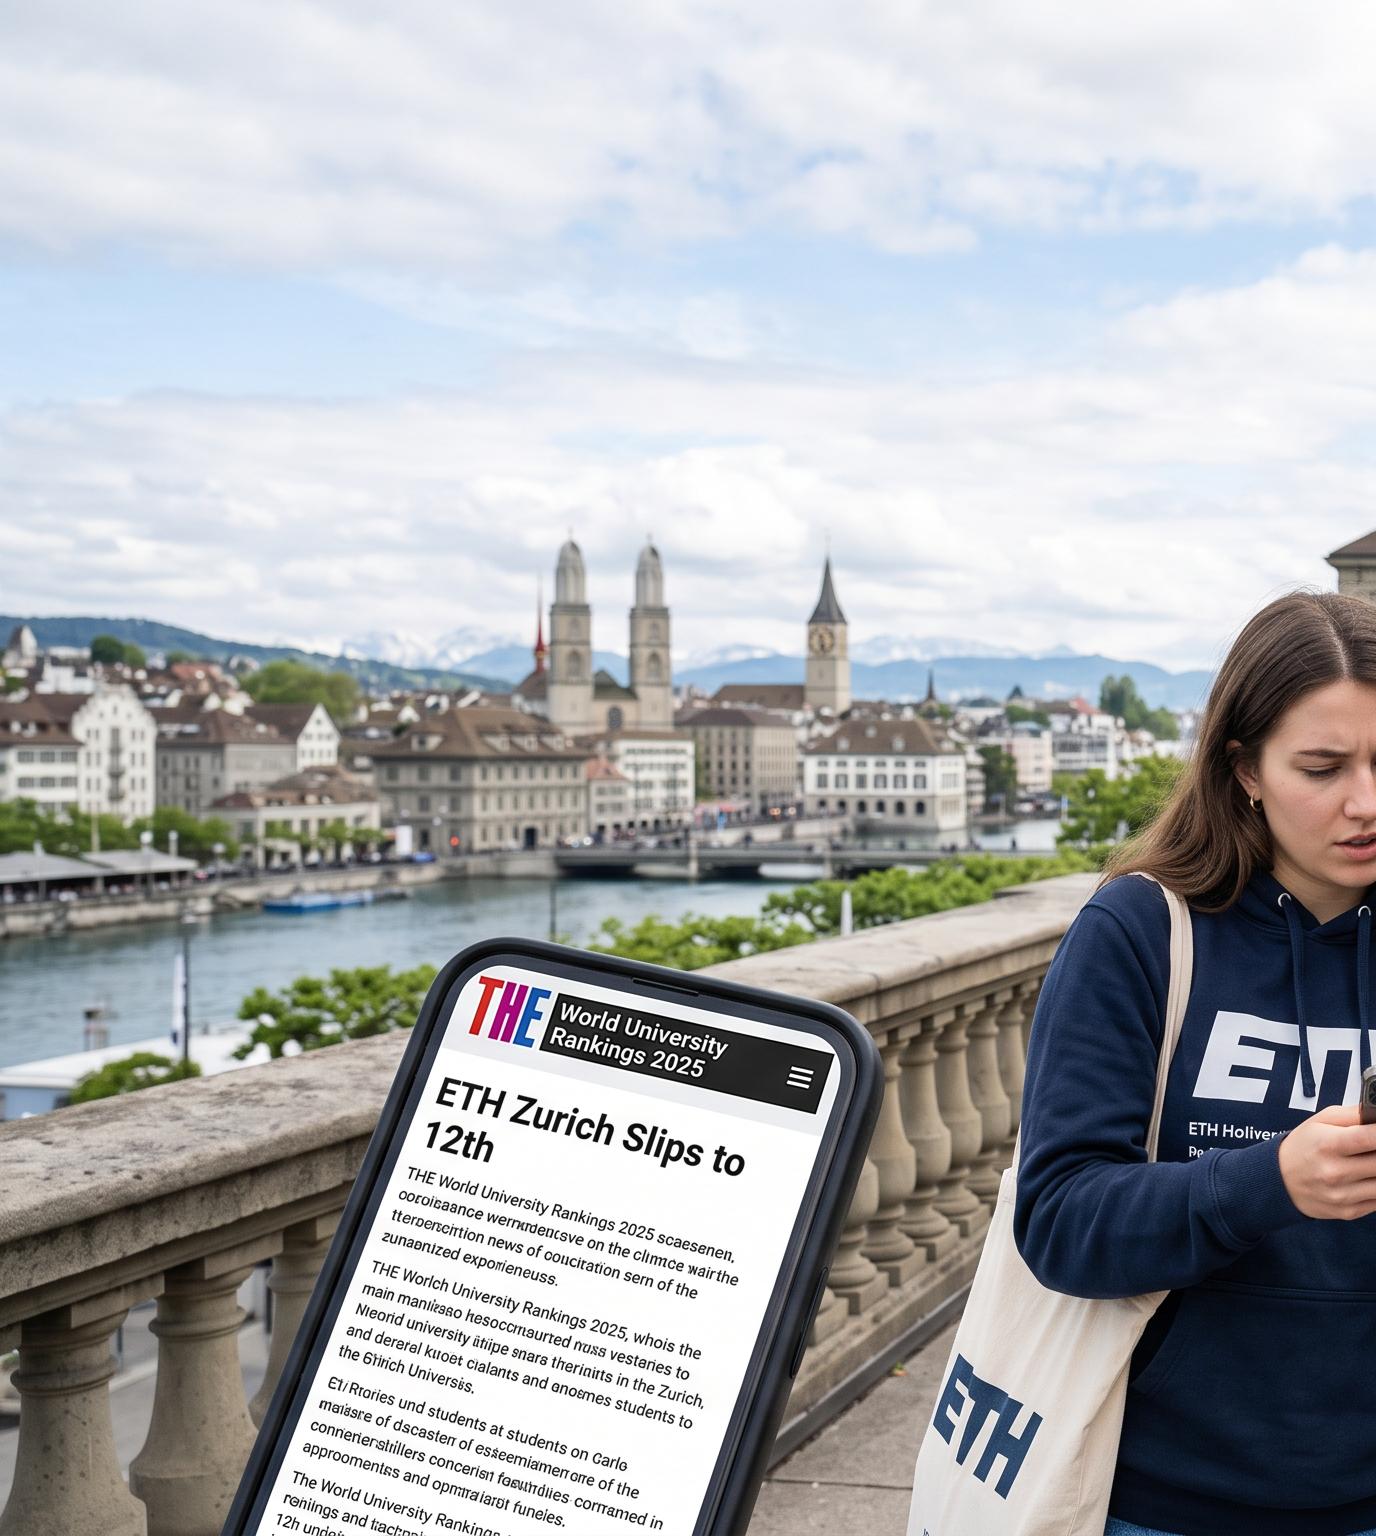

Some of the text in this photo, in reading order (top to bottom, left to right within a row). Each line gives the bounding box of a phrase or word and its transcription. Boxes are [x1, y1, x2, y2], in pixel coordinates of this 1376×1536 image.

[468, 976, 551, 1047] THE
[560, 1003, 728, 1060] World University
[550, 1026, 706, 1078] Rankings 2025
[426, 1121, 494, 1163] 12th
[435, 1076, 745, 1176] ETH Zurich Slips to
[1189, 1122, 1287, 1140] ETH Holiver
[408, 1166, 437, 1185] THE
[439, 1174, 479, 1195] World
[480, 1185, 549, 1216] University
[551, 1203, 616, 1231] Rankings
[618, 1221, 655, 1241] 2025
[487, 1236, 524, 1254] news
[526, 1244, 543, 1258] of
[657, 1278, 674, 1292] of
[675, 1282, 698, 1299] the
[586, 1239, 605, 1252] on
[608, 1241, 630, 1258] the
[361, 1284, 395, 1301] main
[675, 1366, 690, 1380] to
[372, 1260, 401, 1279] THE
[451, 1281, 520, 1314] University
[522, 1300, 587, 1330] Rankings
[589, 1318, 628, 1342] 2025,
[634, 1332, 675, 1352] whois
[678, 1343, 701, 1360] the
[338, 1344, 360, 1361] the
[346, 1326, 373, 1341] and
[521, 1374, 549, 1389] and
[614, 1399, 675, 1424] students
[678, 1415, 693, 1429] to
[406, 1318, 471, 1347] university
[616, 1372, 629, 1387] in
[632, 1378, 655, 1395] the
[657, 1384, 704, 1410] Zurich,
[375, 1415, 392, 1428] of
[598, 1478, 615, 1491] of
[616, 1482, 640, 1499] the
[398, 1398, 426, 1414] und
[427, 1407, 487, 1432] students
[489, 1424, 504, 1437] at
[506, 1429, 568, 1455] students
[570, 1447, 589, 1461] on
[933, 1353, 1043, 1500] ETH
[293, 1470, 317, 1489] The
[321, 1478, 362, 1502] World
[363, 1491, 433, 1525] University
[402, 1471, 430, 1487] and
[341, 1512, 369, 1527] and
[649, 1515, 663, 1530] in
